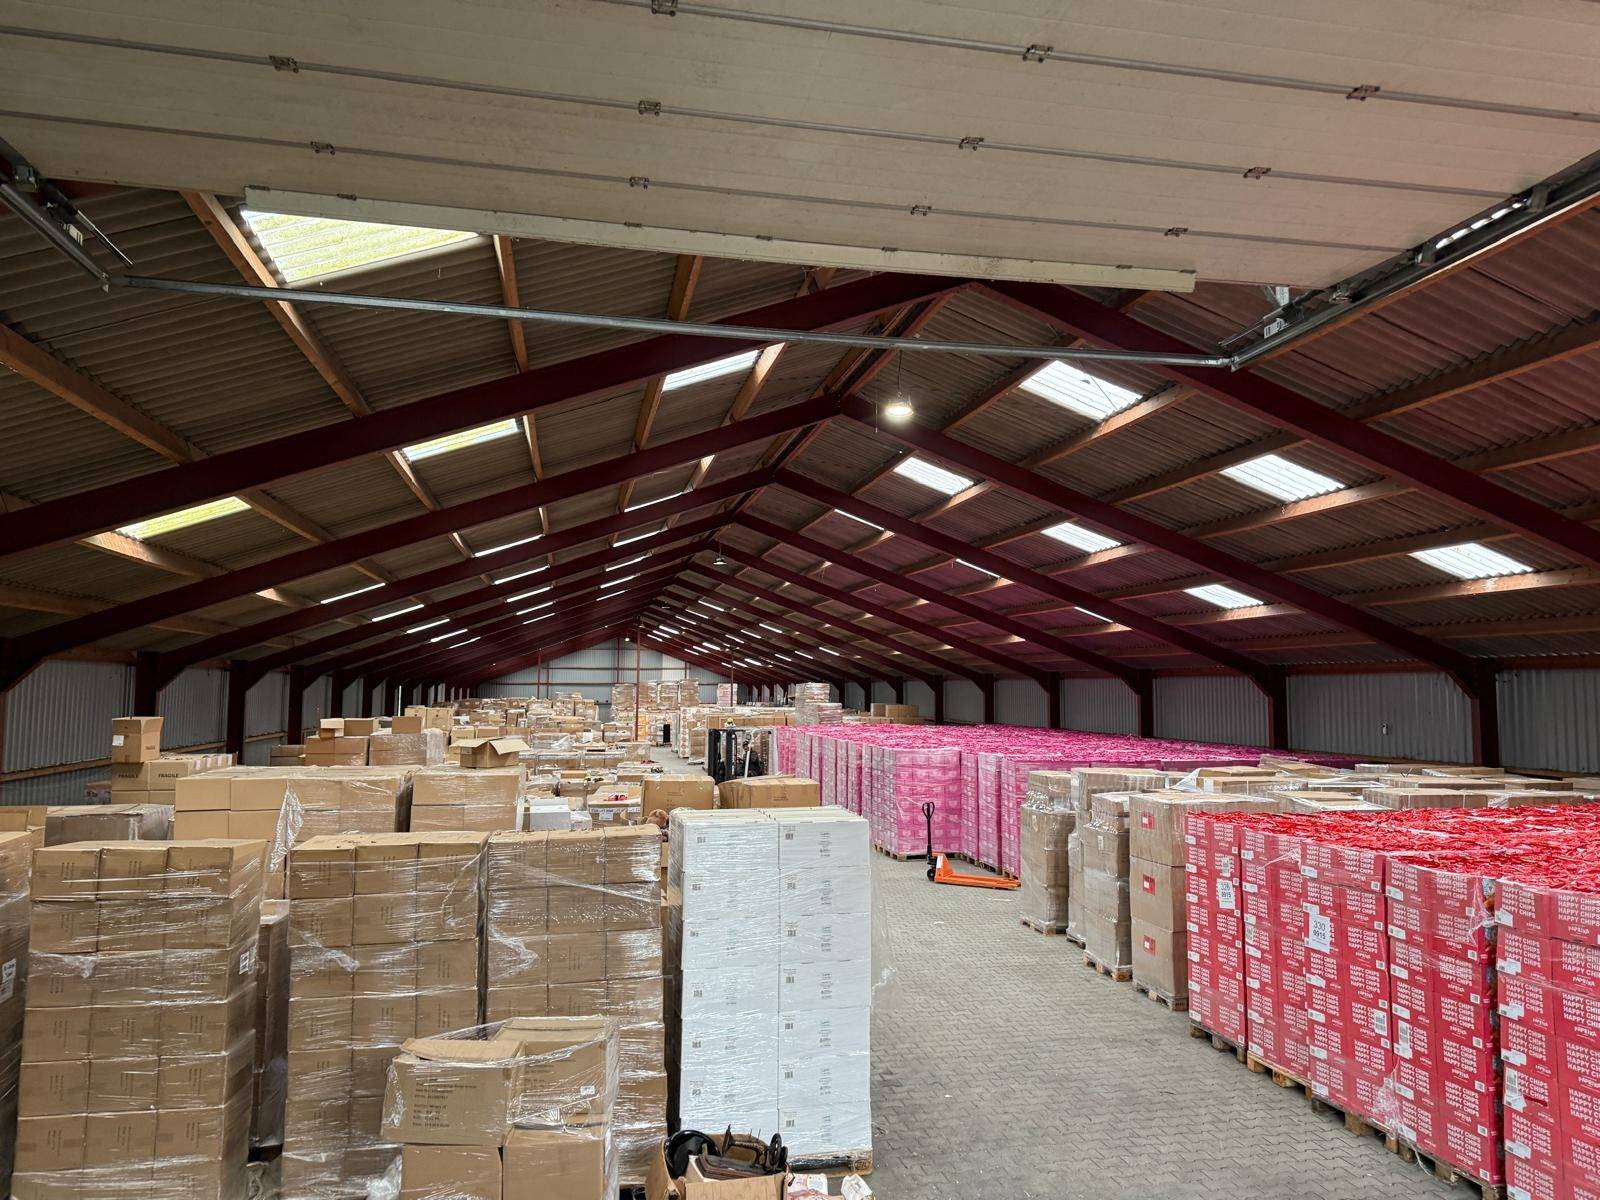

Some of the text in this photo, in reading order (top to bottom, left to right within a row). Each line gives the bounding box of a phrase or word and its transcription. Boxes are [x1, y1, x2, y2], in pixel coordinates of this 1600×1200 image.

[1313, 920, 1325, 931] 330
[1313, 930, 1325, 939] 0915
[1562, 992, 1584, 1003] HAPPY
[1563, 999, 1584, 1010] HAPPY
[1563, 1006, 1584, 1016] HAPPY
[1564, 1013, 1584, 1023] HAPPY
[1566, 1042, 1588, 1054] HAPPY
[1566, 1049, 1588, 1061] HAPPY
[1567, 1056, 1589, 1068] HAPPY
[1568, 1063, 1589, 1075] HAPPY
[1569, 1088, 1591, 1101] HAPPY
[1570, 1095, 1592, 1108] HAPPY
[1570, 1102, 1592, 1116] HAPPY
[1571, 1109, 1592, 1123] HAPPY
